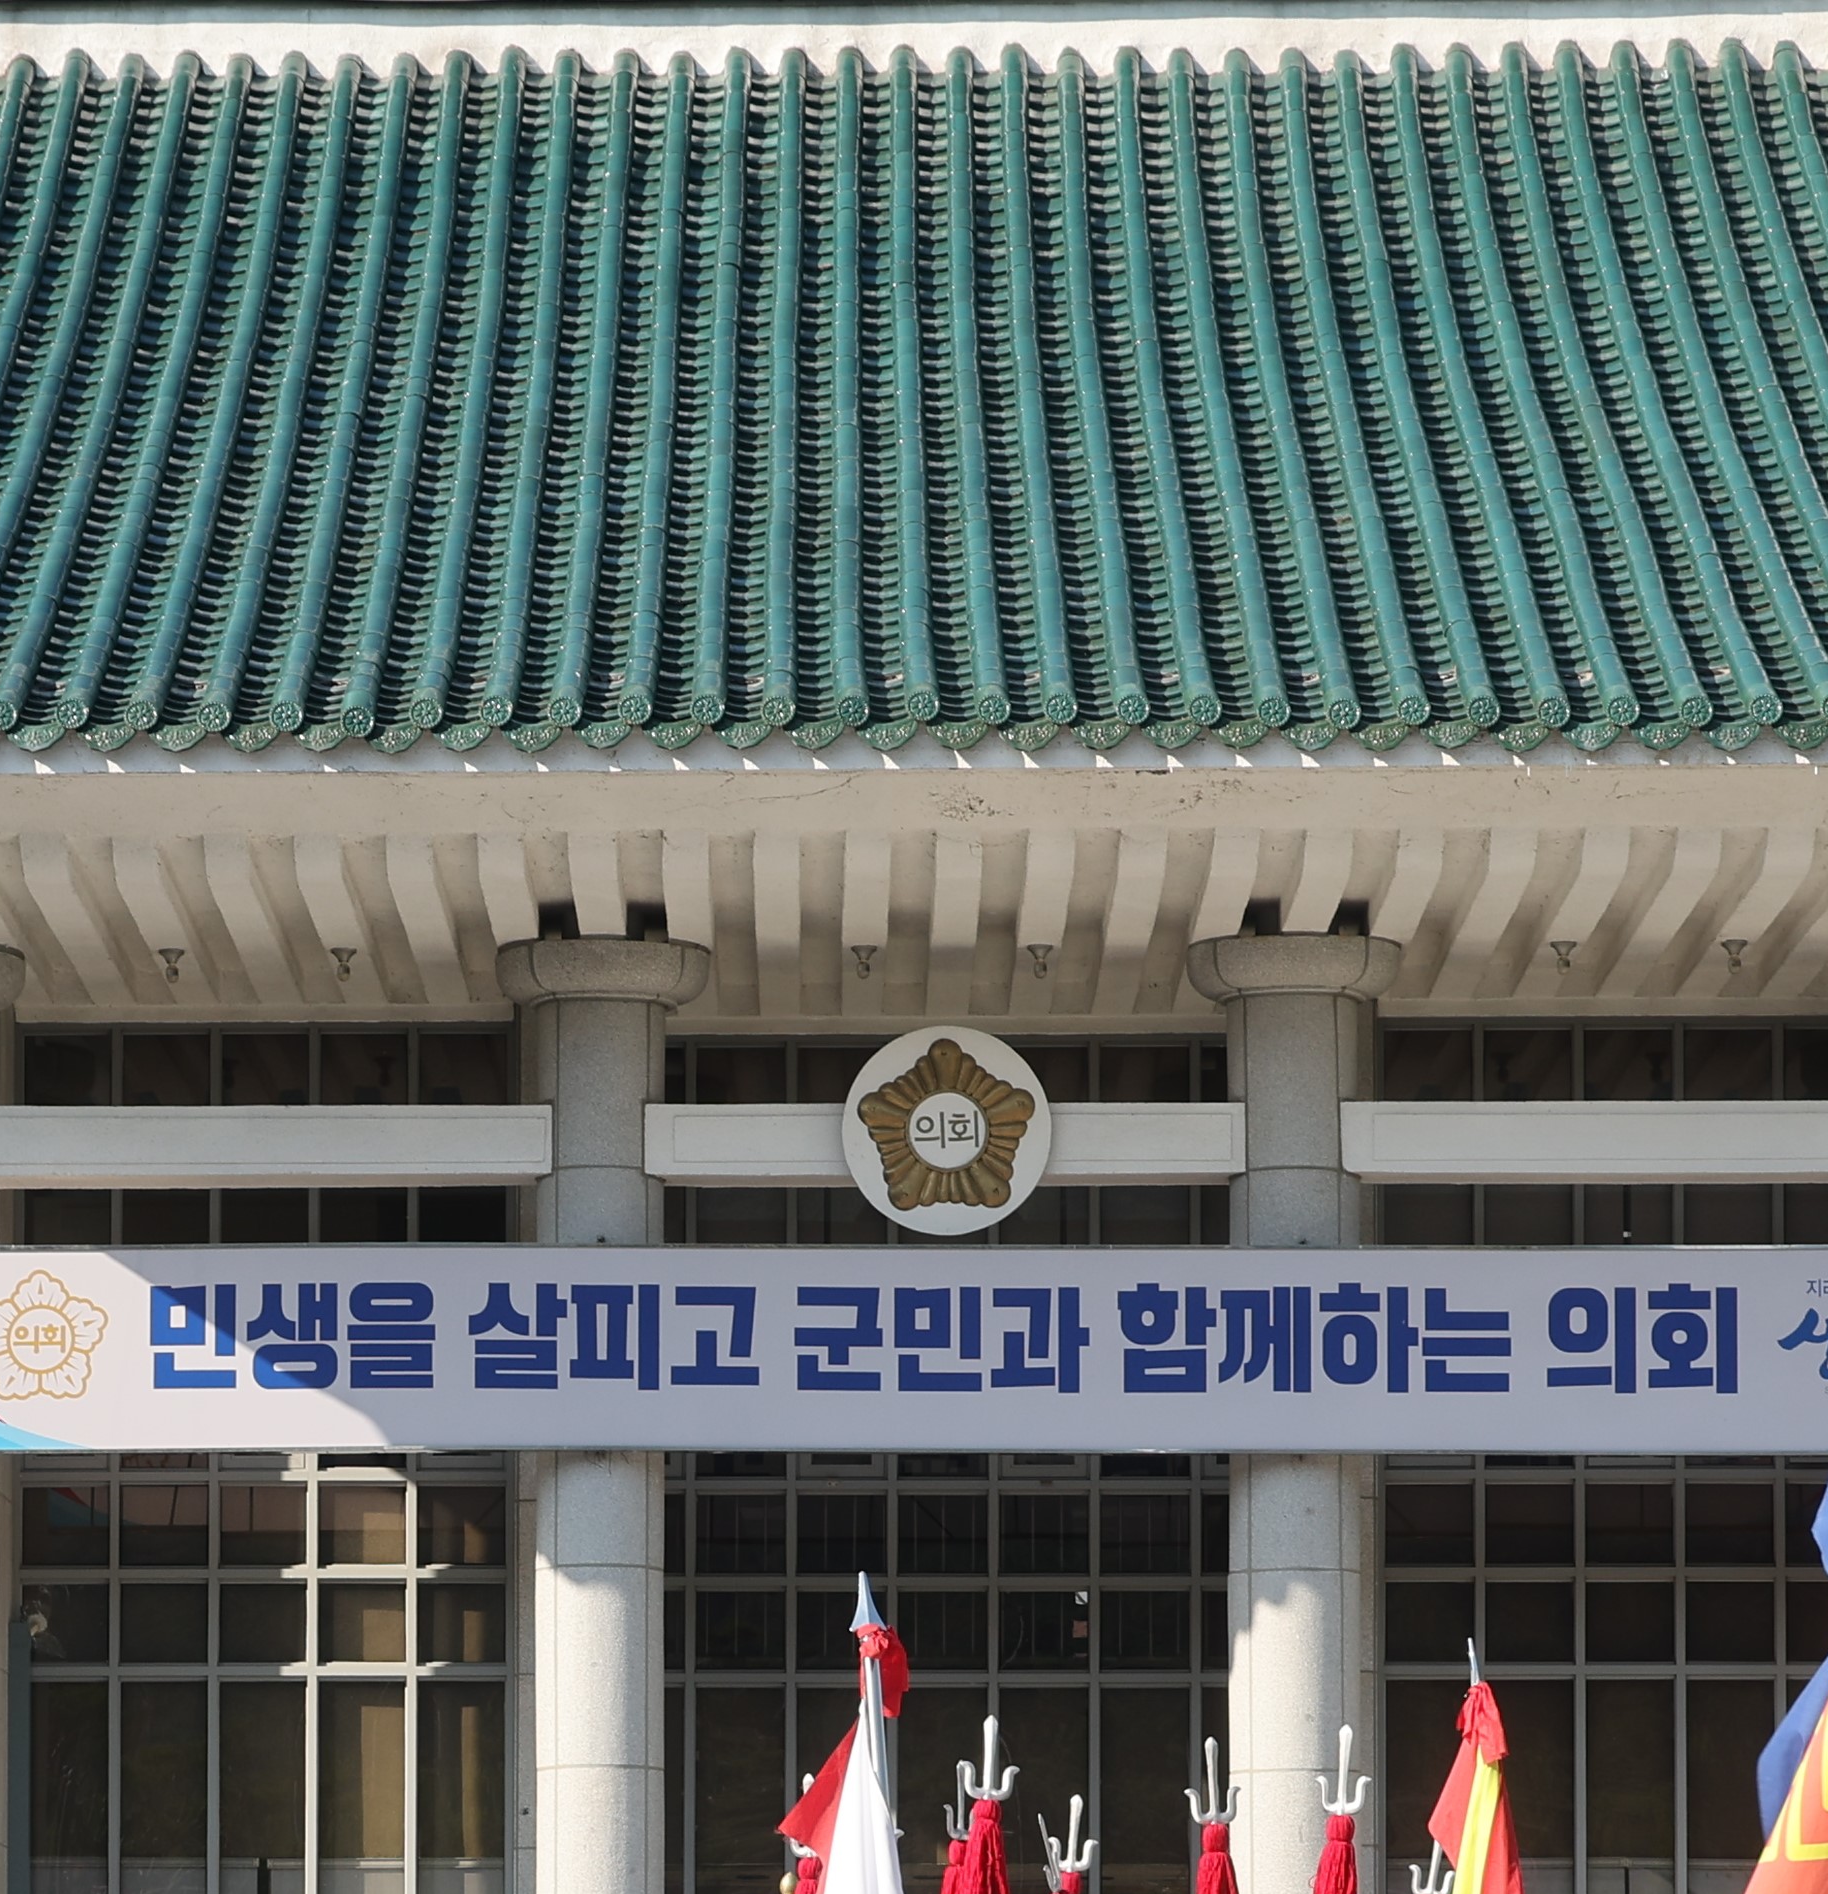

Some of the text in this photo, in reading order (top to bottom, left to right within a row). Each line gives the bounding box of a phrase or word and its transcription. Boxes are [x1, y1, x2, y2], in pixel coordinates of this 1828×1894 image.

[914, 1110, 980, 1149] 의회
[13, 1323, 66, 1354] 의회
[150, 1281, 1739, 1394] 민생을 살피고 군민과 함께하는 의회
